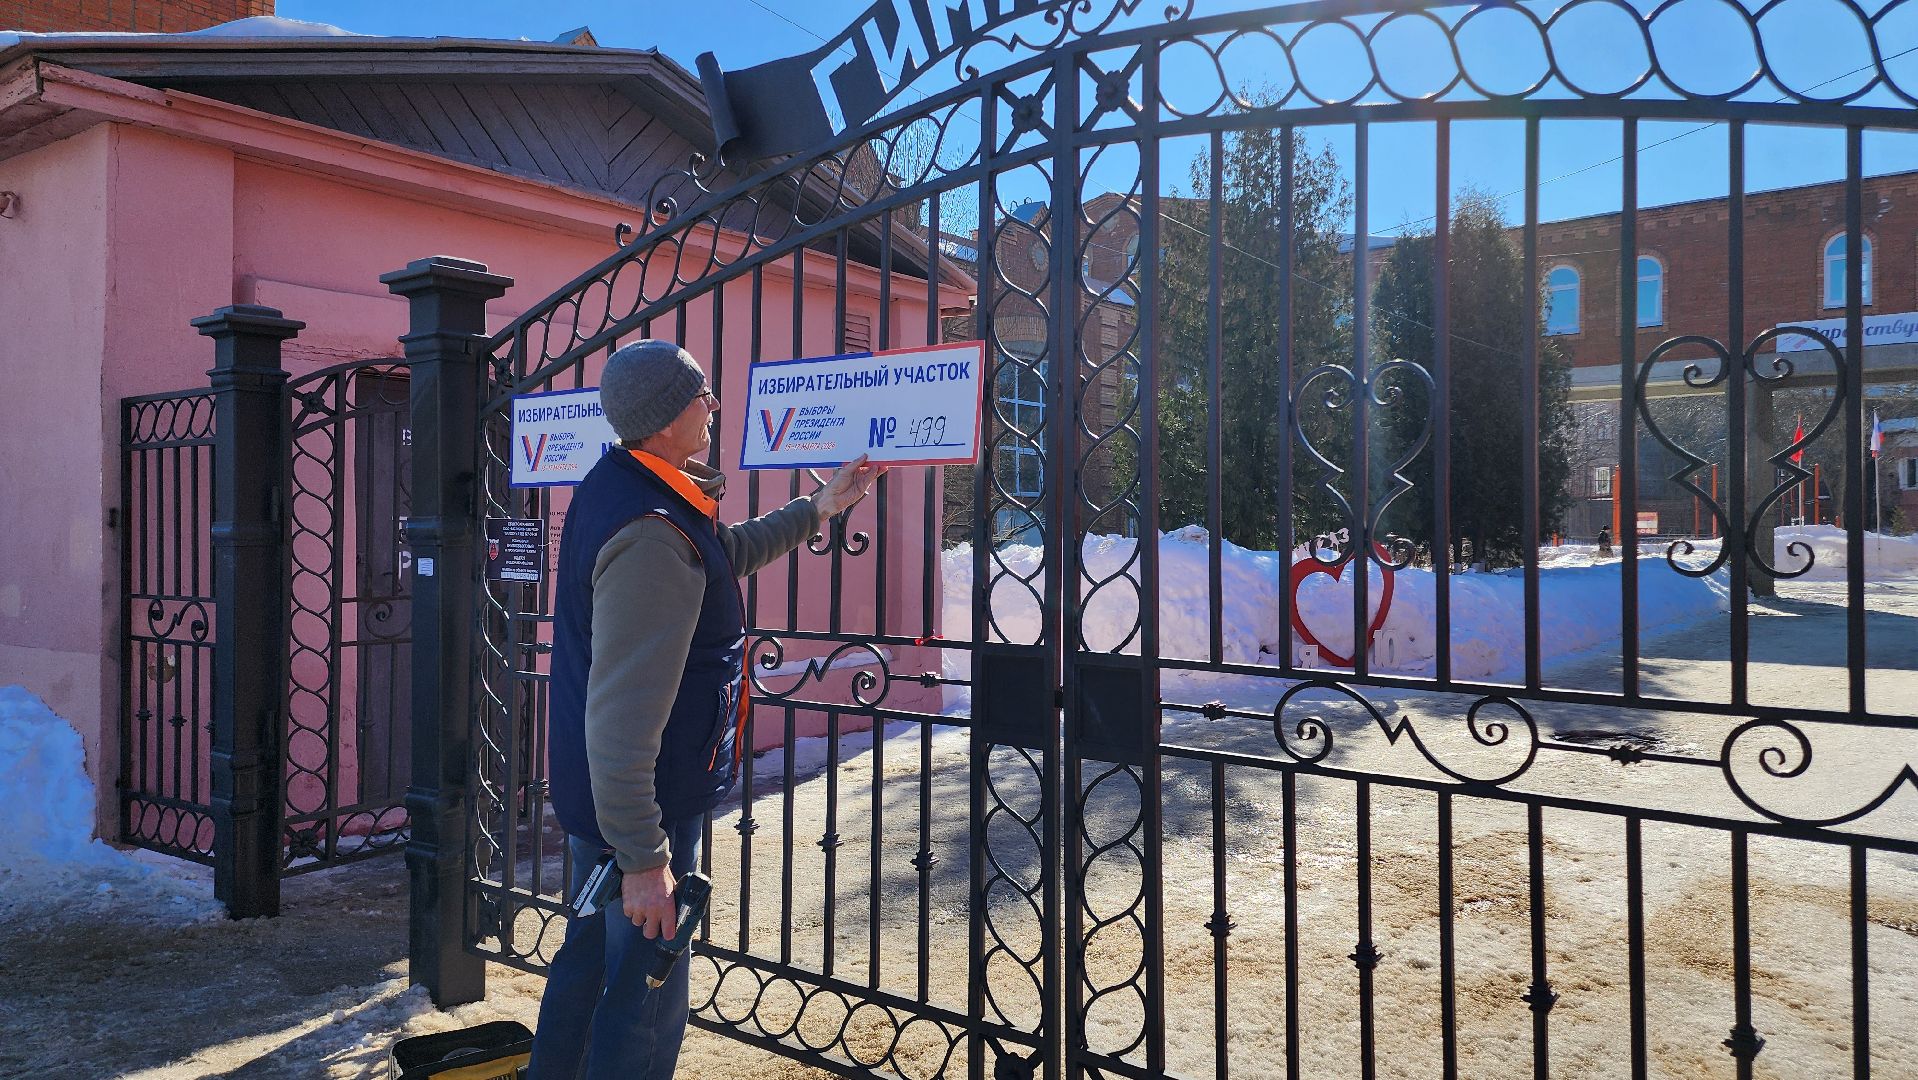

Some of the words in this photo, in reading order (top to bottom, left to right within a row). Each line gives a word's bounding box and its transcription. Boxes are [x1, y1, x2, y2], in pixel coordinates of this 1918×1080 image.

[810, 0, 1052, 137] ГИМ
[758, 365, 888, 395] ИЗБИРАТЕЛЬНЫЙ
[894, 361, 971, 385] УЧАСТОК
[518, 402, 606, 423] ИЗБИРАТЕЛЬНЫ
[794, 417, 845, 429] ПРЕЗИДЕНТА
[799, 405, 836, 417] ВЫБОРЫ
[788, 430, 822, 441] РОССИИ
[868, 416, 897, 448] №
[909, 415, 947, 447] 499
